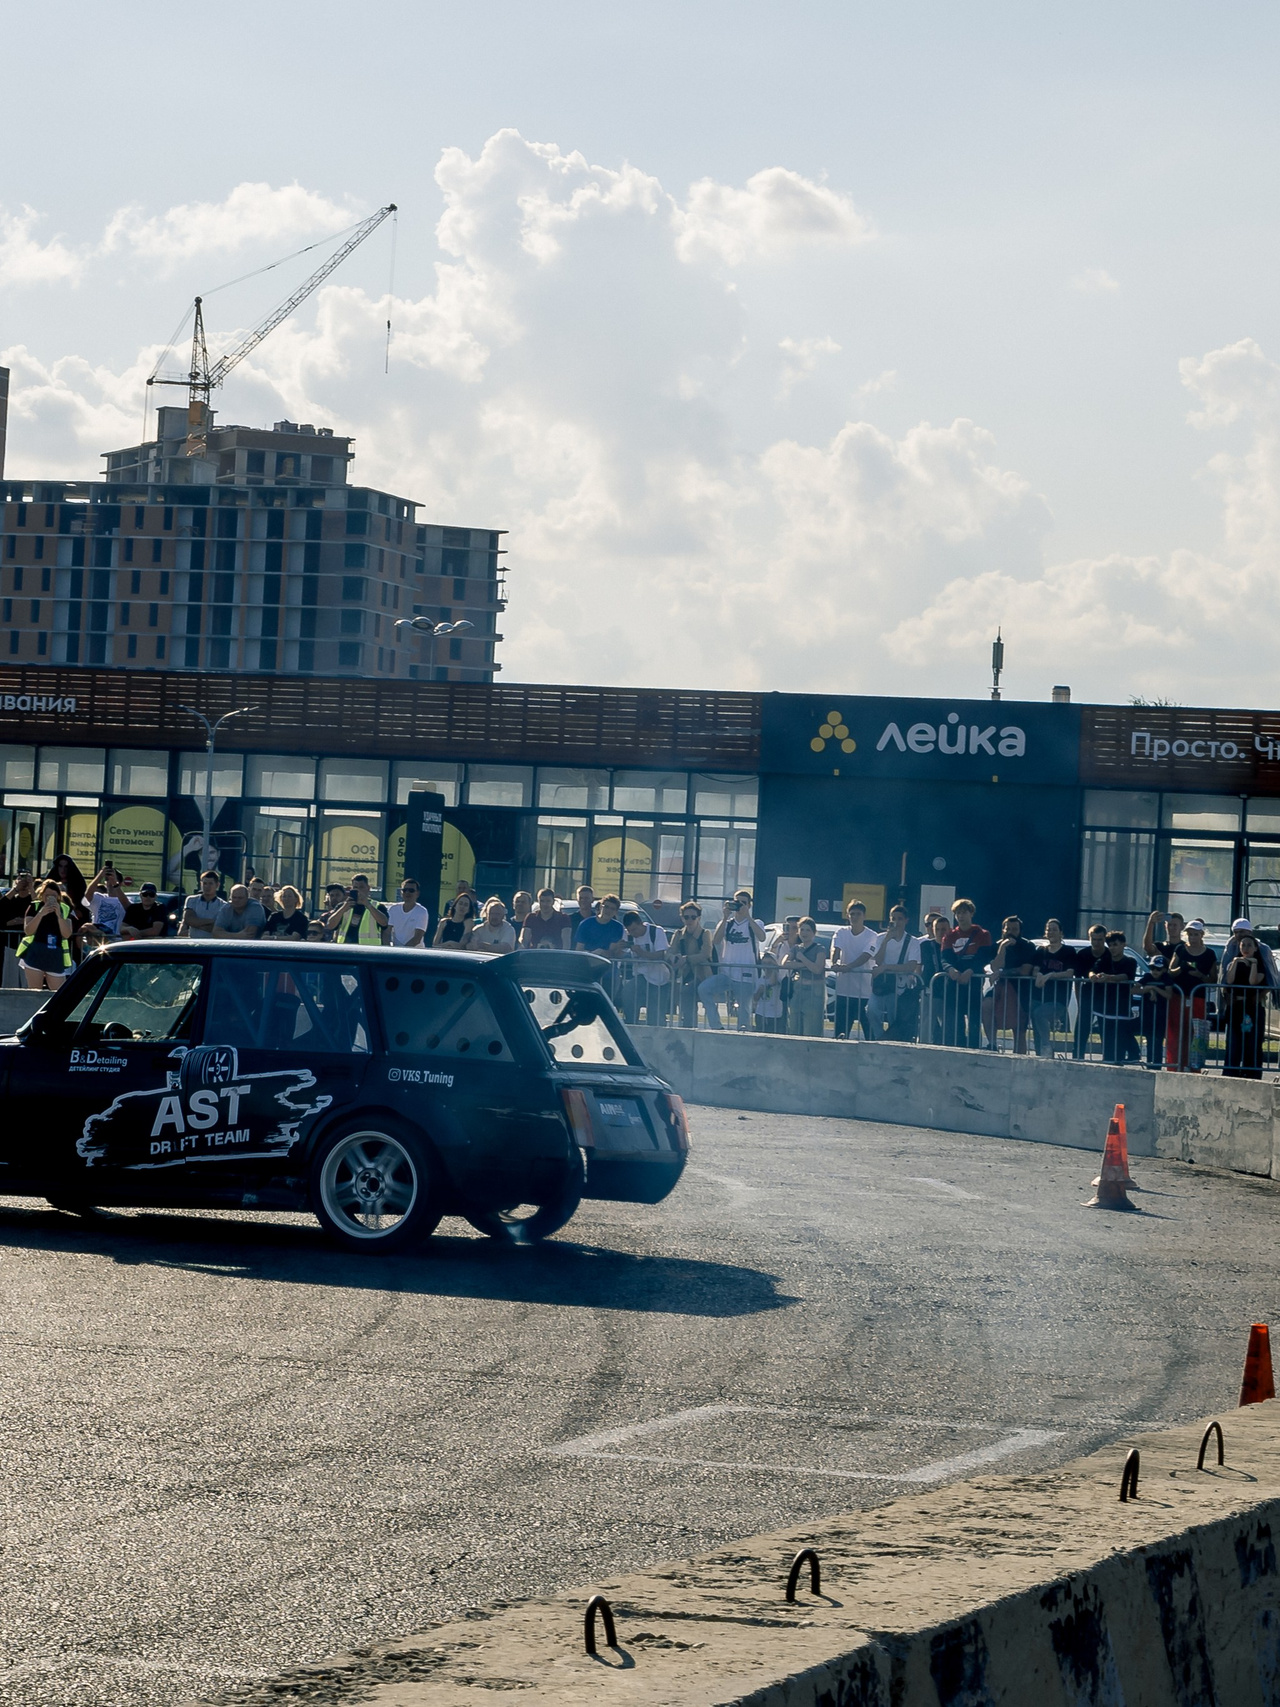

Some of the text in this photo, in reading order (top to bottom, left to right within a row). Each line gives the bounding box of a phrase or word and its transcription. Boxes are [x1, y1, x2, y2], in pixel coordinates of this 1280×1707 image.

[1131, 731, 1246, 761] Просто.
[109, 826, 164, 837] Сеть умных
[109, 838, 154, 846] автомоек
[402, 1069, 455, 1088] VKS_Tuning
[150, 1084, 251, 1137] AST
[205, 1128, 250, 1146] TEAM
